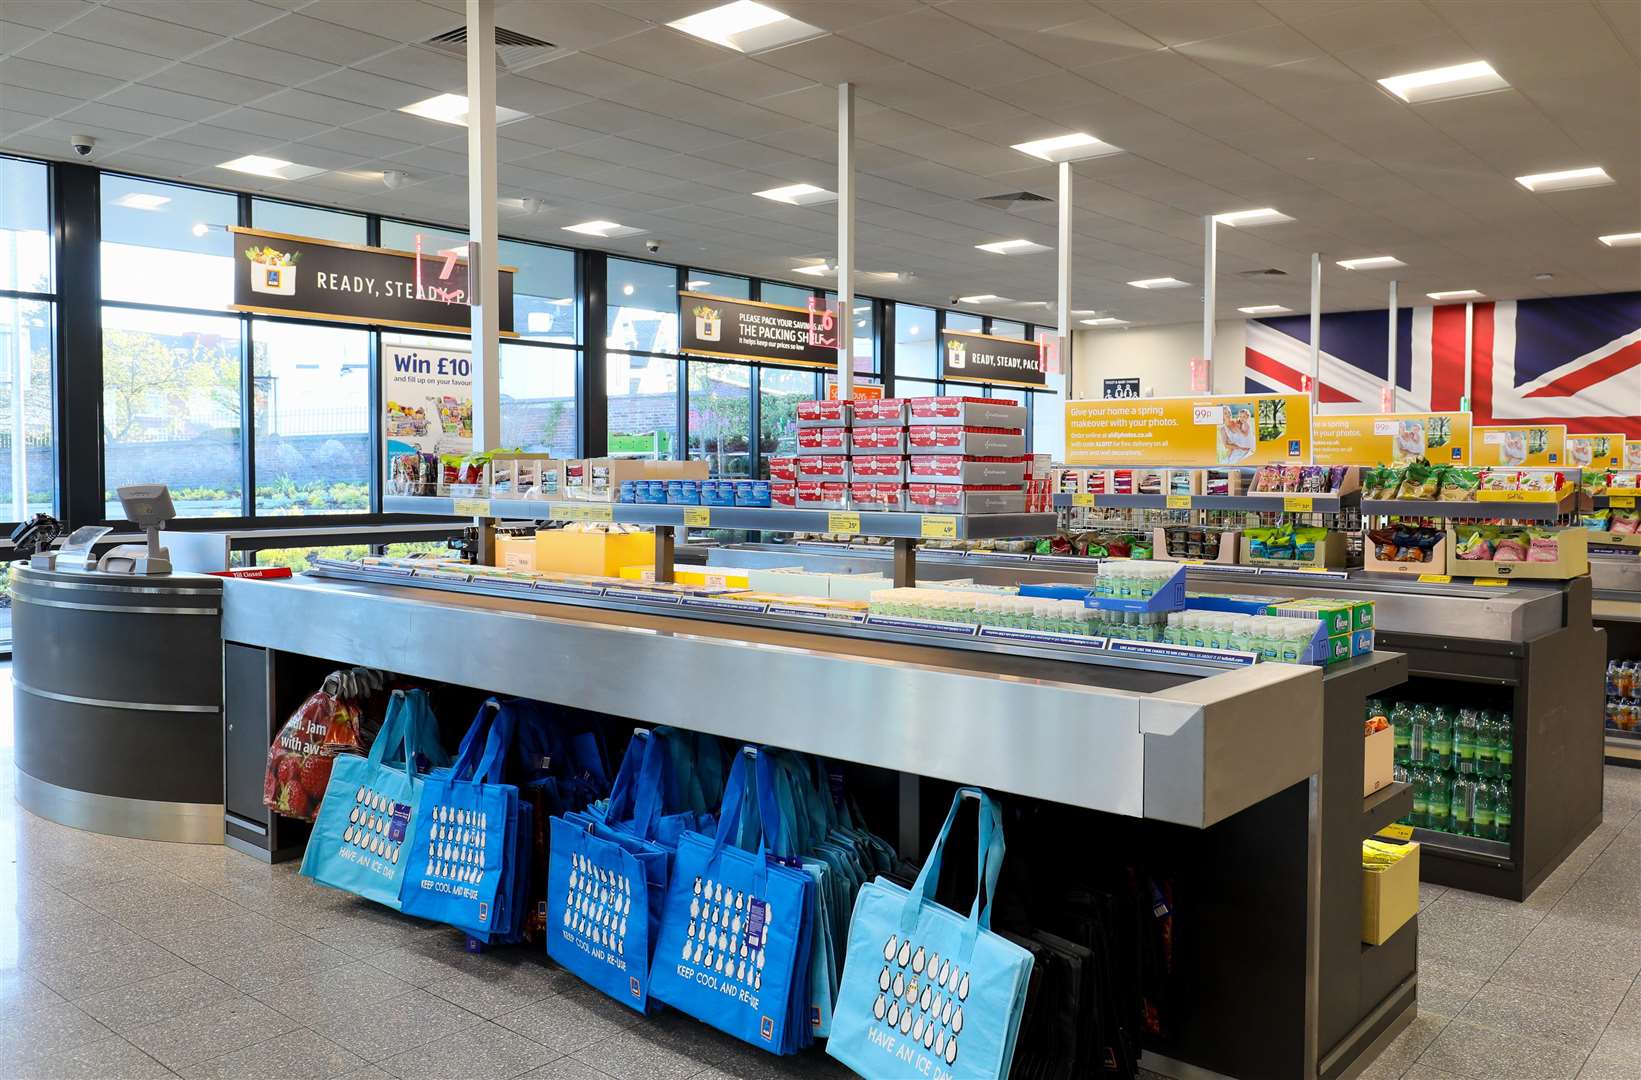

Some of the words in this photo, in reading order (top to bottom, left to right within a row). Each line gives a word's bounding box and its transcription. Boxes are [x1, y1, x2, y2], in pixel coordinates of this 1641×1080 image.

[437, 249, 458, 280] 7
[317, 271, 380, 298] READY,
[739, 313, 761, 324] PLEASE
[761, 316, 777, 325] PACK
[777, 318, 793, 328] YOUR
[822, 309, 833, 331] 6
[739, 323, 758, 337] THE
[759, 326, 796, 342] PACKING
[743, 337, 756, 345] helps
[756, 339, 768, 347] keep
[776, 341, 790, 350] prices
[394, 353, 430, 374] Win
[437, 357, 472, 377] £10
[972, 353, 996, 367] READY,
[997, 356, 1022, 370] STEADY,
[1023, 359, 1039, 370] PACK
[1071, 408, 1087, 416] Give
[1088, 408, 1105, 417] your
[1107, 407, 1128, 416] home
[1138, 406, 1164, 416] spring
[1071, 418, 1108, 427] makeover
[1110, 418, 1127, 427] with
[1128, 419, 1146, 429] your
[1148, 417, 1178, 427] photos.
[306, 719, 327, 736] Jam
[281, 736, 302, 751] with
[340, 847, 356, 861] HAVE
[357, 856, 370, 867] AN
[371, 861, 383, 873] ICE
[383, 866, 396, 880] DAY
[421, 880, 434, 889] KEEP
[435, 882, 452, 893] COOL
[452, 884, 464, 896] AND
[562, 930, 575, 943] KEEP
[575, 938, 591, 953] COOL
[591, 947, 605, 960] AND
[677, 964, 694, 979] KEEP
[696, 972, 718, 990] COOL
[720, 982, 737, 997] AND
[868, 1026, 896, 1052] HAVE
[895, 1044, 914, 1065] AN
[915, 1054, 932, 1077] ICE
